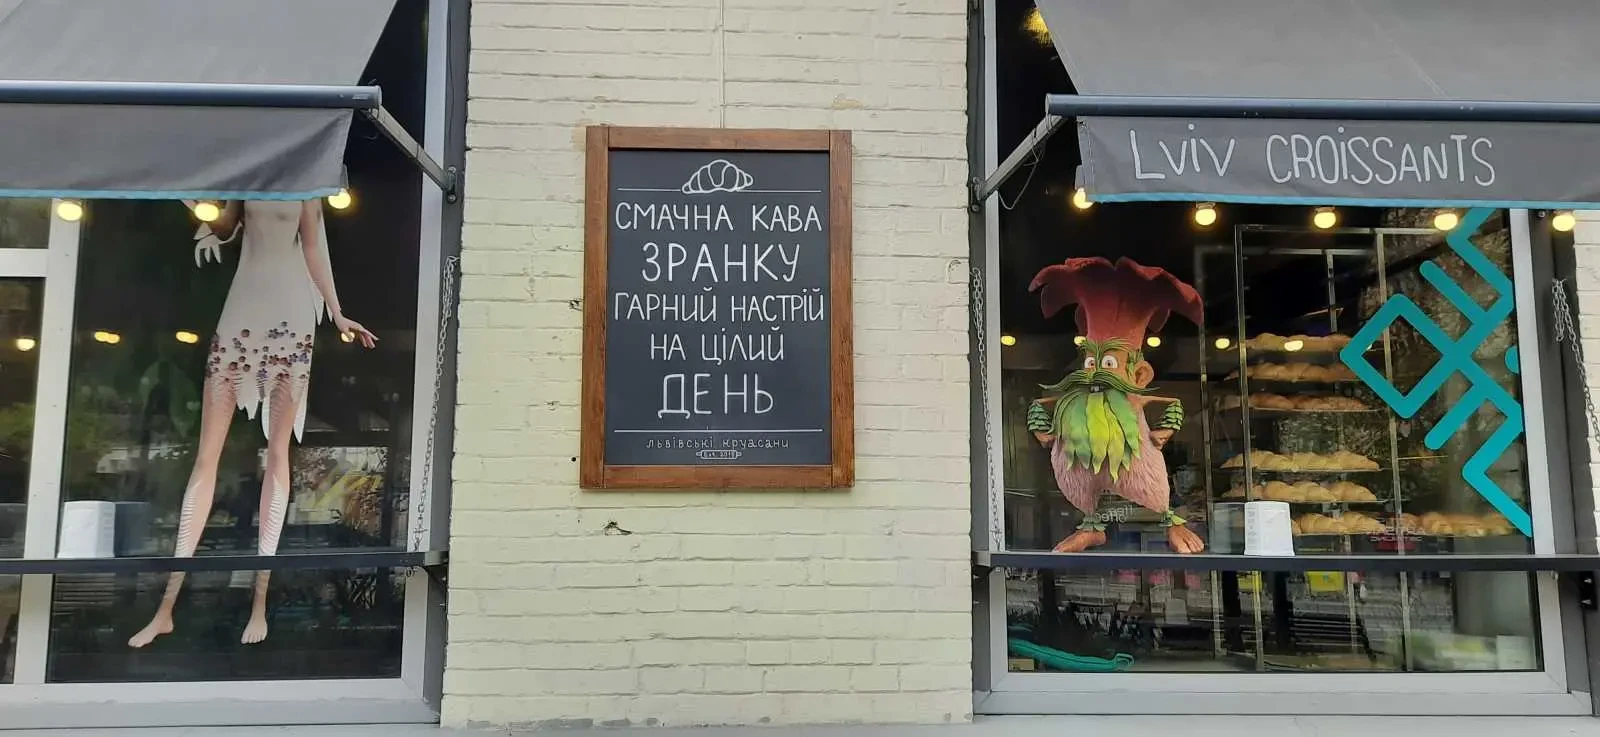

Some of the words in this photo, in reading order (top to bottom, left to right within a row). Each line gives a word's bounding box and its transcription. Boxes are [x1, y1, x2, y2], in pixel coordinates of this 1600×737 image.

[615, 201, 734, 232] СМАЧНА
[752, 204, 823, 232] КАВА
[641, 241, 800, 283] ЗРАНКУ
[614, 286, 717, 322] ГАРНИЙ
[731, 287, 824, 322] НАСТРІЙ
[650, 333, 687, 361] НА
[701, 326, 784, 366] ЦІЛИЙ
[657, 372, 774, 420] ДЕНЬ
[646, 436, 713, 449] львівські
[722, 438, 789, 451] круасани
